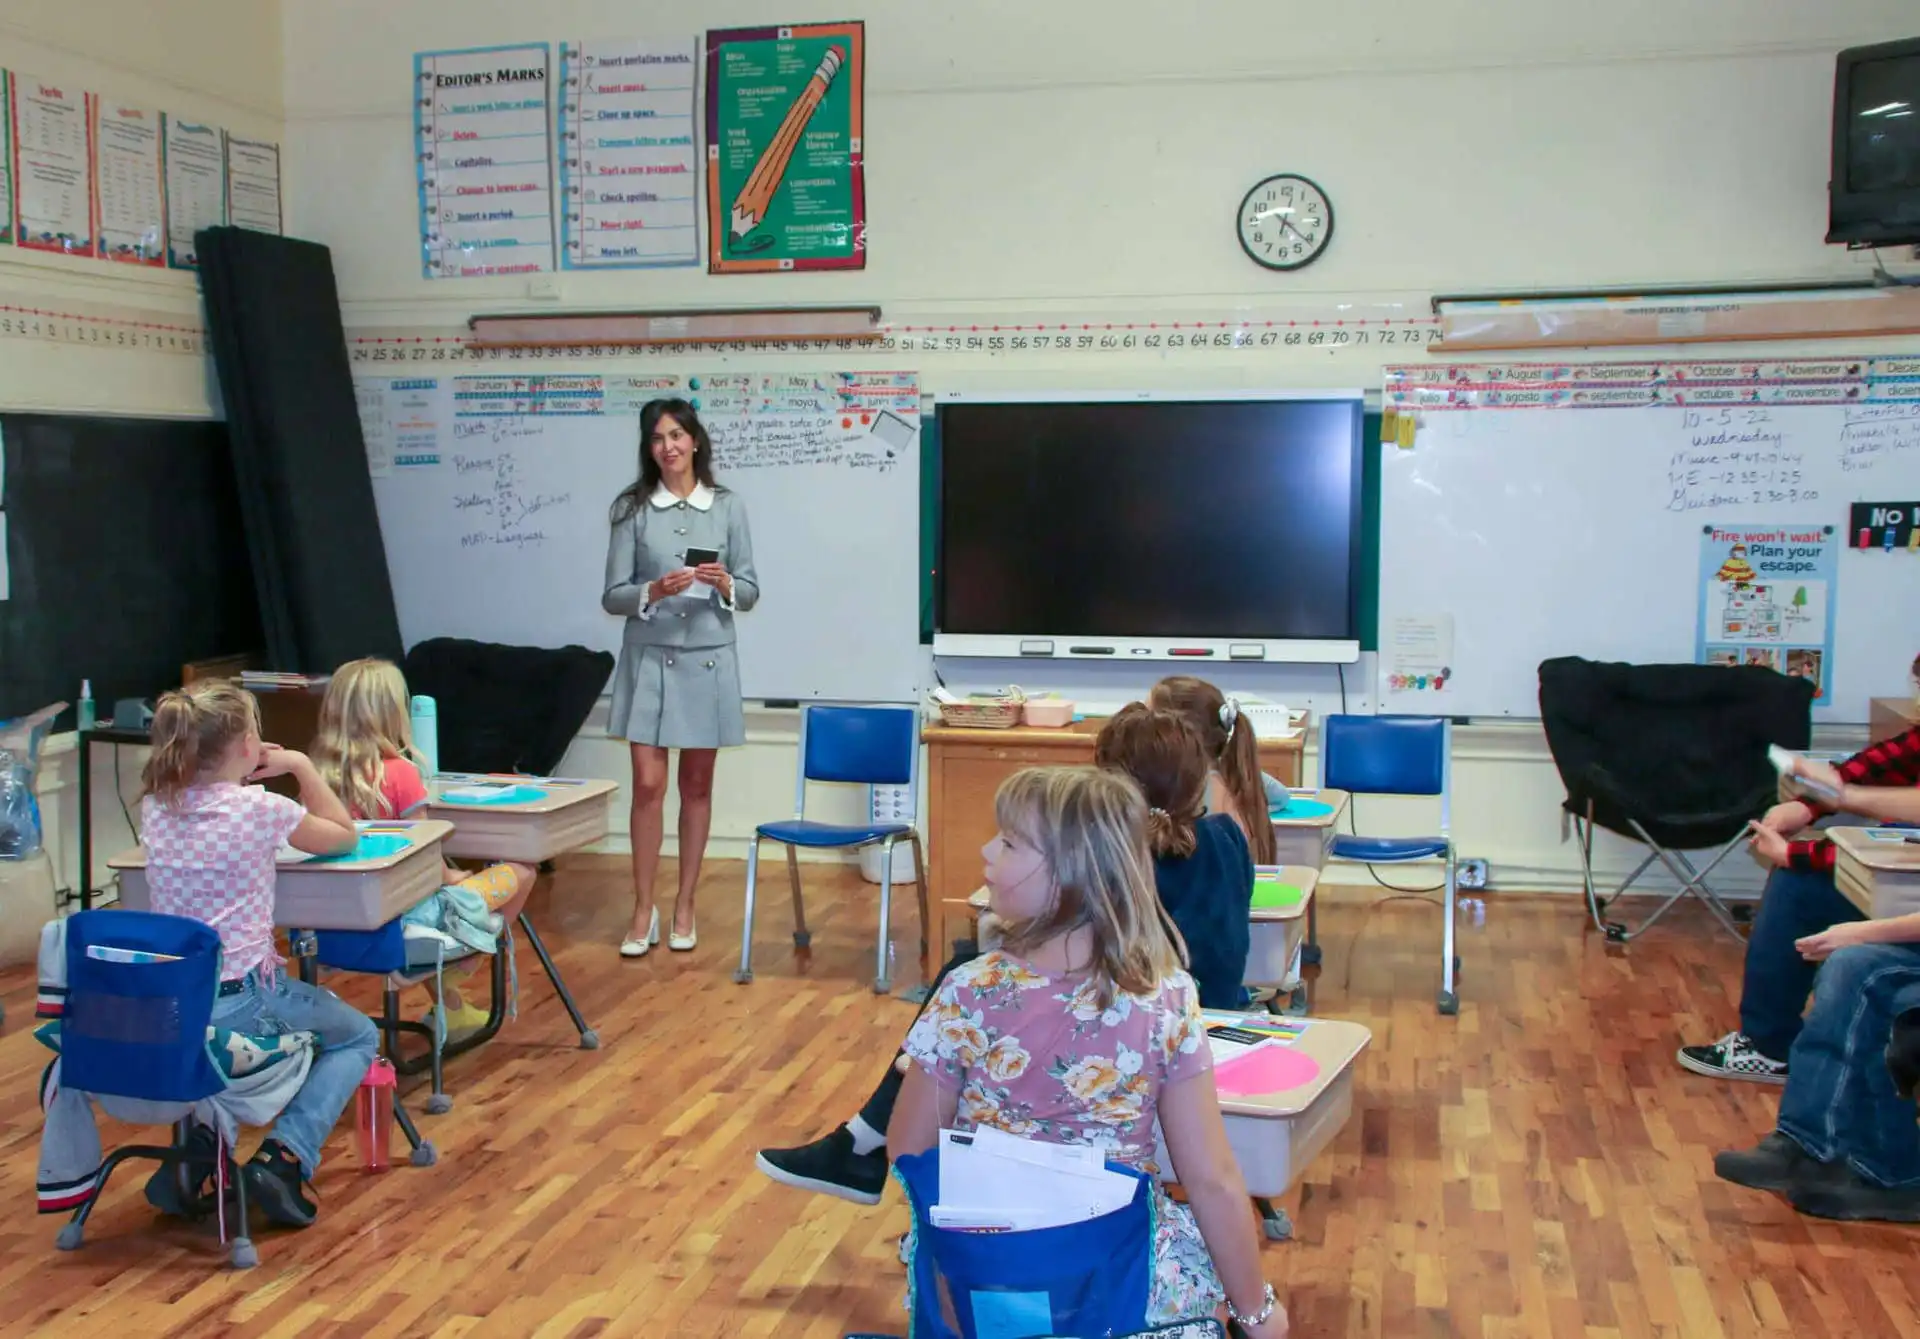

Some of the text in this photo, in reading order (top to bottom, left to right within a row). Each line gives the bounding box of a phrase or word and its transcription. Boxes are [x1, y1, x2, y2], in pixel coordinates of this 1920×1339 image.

[437, 68, 545, 87] EDITOR'S MARKS
[599, 110, 618, 120] Close
[1267, 191, 1276, 201] 11
[1281, 186, 1294, 197] 12
[1301, 191, 1305, 201] 1
[601, 193, 624, 202] Check
[1254, 202, 1267, 213] 10
[1308, 203, 1317, 213] 2
[1313, 217, 1321, 227] 3
[1254, 232, 1263, 243] 8
[1265, 243, 1273, 253] 7
[1279, 247, 1288, 258] 6
[1294, 244, 1303, 254] 5
[117, 332, 125, 346] 5
[131, 333, 137, 347] 6
[354, 349, 368, 361] 24
[373, 349, 387, 360] 25
[392, 349, 406, 360] 26
[412, 349, 426, 360] 27
[432, 350, 445, 360] 28
[451, 350, 465, 360] 29
[470, 350, 483, 360] 30
[490, 350, 501, 359] 31
[509, 349, 523, 359] 32
[548, 349, 561, 357] 34
[568, 348, 581, 357] 35
[588, 348, 602, 356] 36
[609, 347, 622, 355] 37
[692, 343, 702, 352] 41
[710, 342, 724, 352] 42
[731, 342, 746, 352] 43
[751, 341, 766, 352] 44
[774, 341, 789, 351] 45
[794, 341, 809, 351] 46
[815, 340, 830, 351] 47
[837, 340, 852, 350] 48
[859, 339, 874, 349] 49
[881, 339, 896, 349] 50
[902, 339, 914, 350] 51
[923, 338, 938, 350] 52
[946, 338, 961, 350] 53
[967, 338, 983, 349] 54
[988, 338, 1004, 349] 55
[1012, 337, 1027, 349] 56
[1033, 337, 1050, 348] 57
[1057, 337, 1072, 348] 58
[1078, 336, 1093, 348] 59
[1101, 336, 1117, 348] 60
[1124, 335, 1136, 347] 61
[1145, 335, 1161, 347] 62
[1168, 334, 1184, 346] 63
[1191, 334, 1208, 346] 64
[1214, 334, 1231, 345] 65
[1237, 333, 1253, 345] 66
[1261, 333, 1277, 345] 67
[1285, 333, 1301, 345] 68
[1308, 333, 1324, 344] 69
[1332, 332, 1349, 344] 70
[1356, 332, 1369, 343] 71
[1379, 331, 1396, 343] 72
[1403, 331, 1420, 342] 73
[1427, 331, 1444, 342] 74
[1590, 368, 1646, 381] September
[1693, 366, 1737, 378] October
[1786, 364, 1841, 376] November
[867, 377, 889, 386] June
[1422, 369, 1542, 384] July August
[474, 381, 508, 391] January
[548, 380, 584, 390] February
[710, 378, 729, 388] April
[789, 378, 808, 389] May
[1505, 392, 1540, 404] agosto
[1694, 388, 1734, 399] octubre
[1786, 387, 1840, 398] noviembre
[710, 397, 729, 407] abril
[1871, 508, 1904, 527] NO
[1712, 529, 1825, 543] Fire won't wait.
[1751, 545, 1822, 560] Plan your
[1760, 560, 1817, 574] escape.
